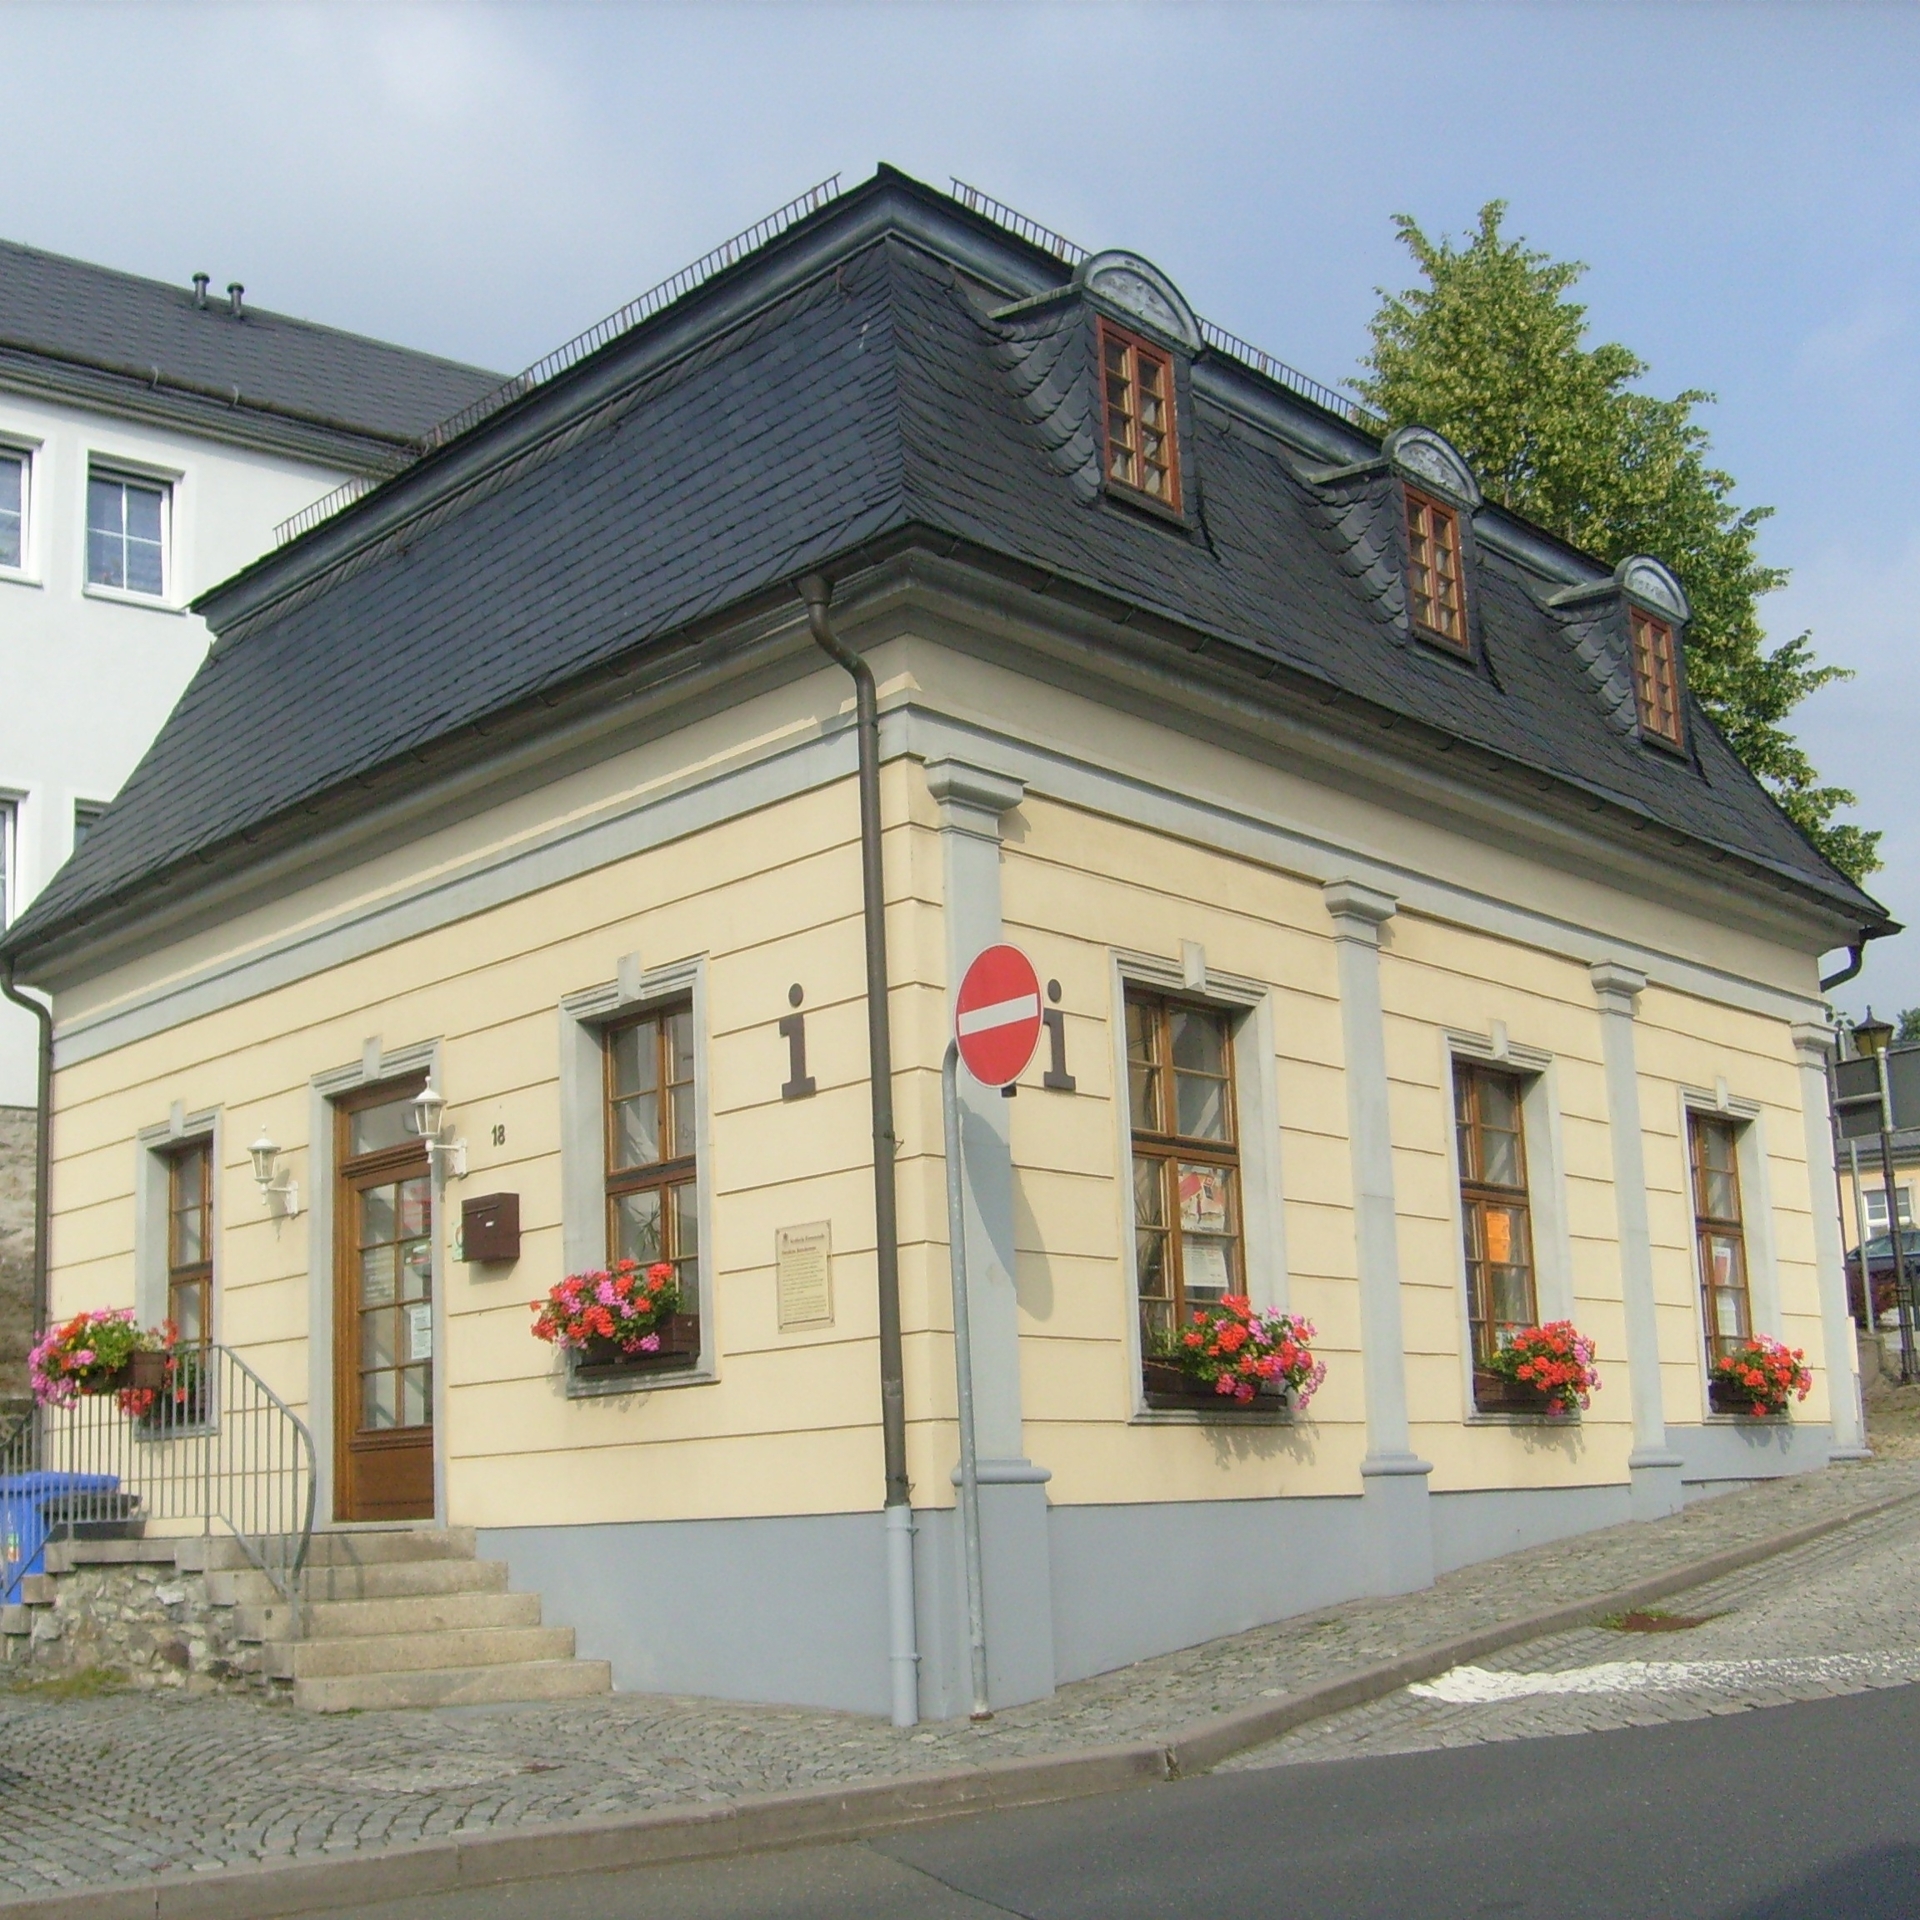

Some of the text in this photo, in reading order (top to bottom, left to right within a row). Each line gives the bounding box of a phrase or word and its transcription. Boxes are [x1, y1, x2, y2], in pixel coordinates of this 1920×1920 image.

[779, 982, 816, 1101] i
[1043, 978, 1076, 1092] i
[491, 1124, 506, 1147] 18
